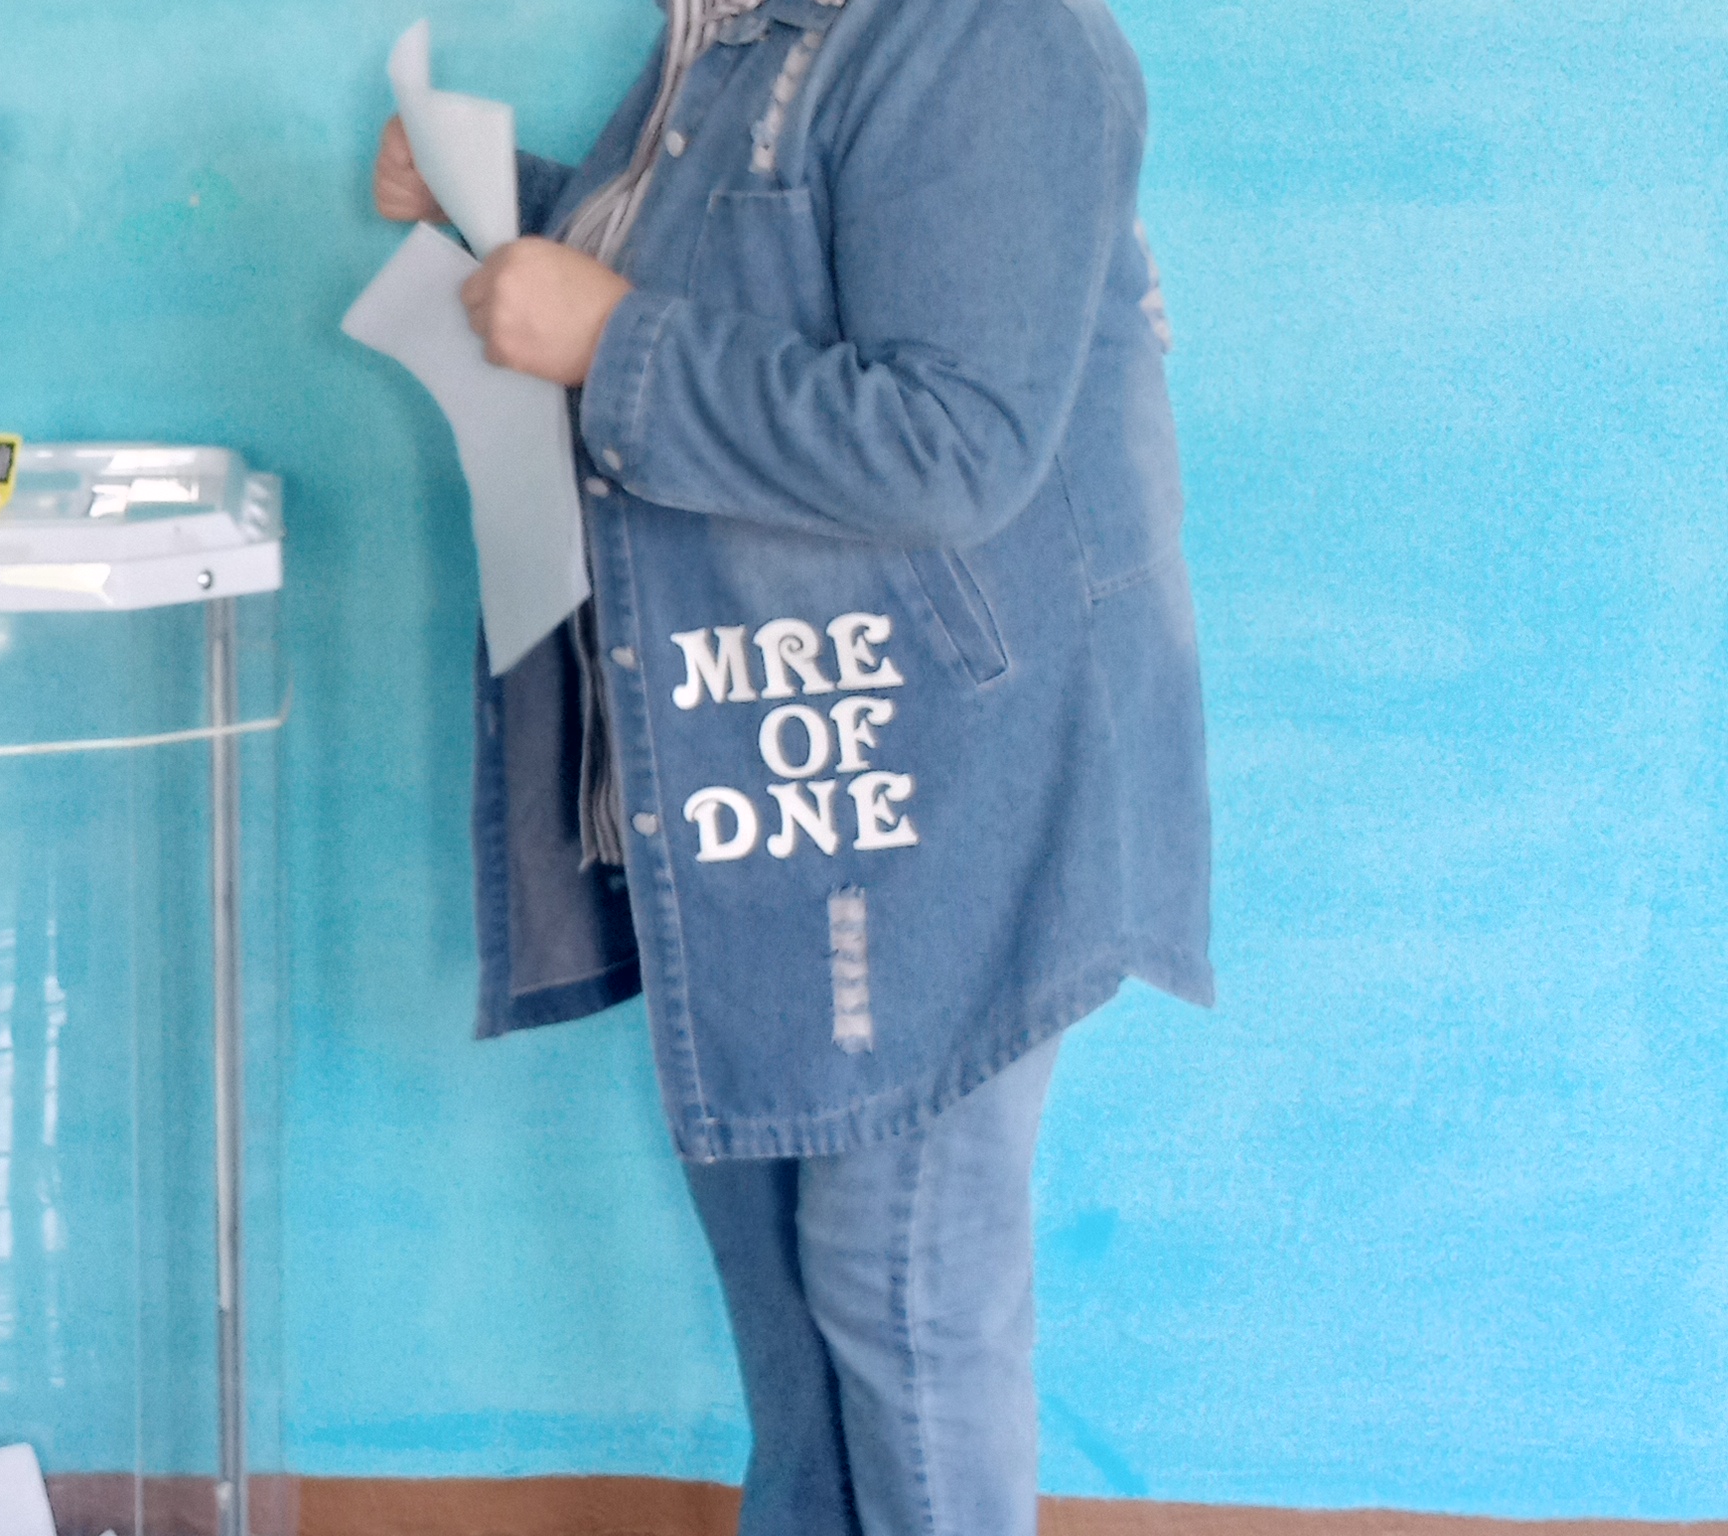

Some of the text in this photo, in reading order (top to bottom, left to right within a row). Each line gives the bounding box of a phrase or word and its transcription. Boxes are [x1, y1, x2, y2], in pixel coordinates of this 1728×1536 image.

[670, 611, 905, 711] MRE
[758, 695, 895, 779] OF
[683, 770, 921, 864] DNE
